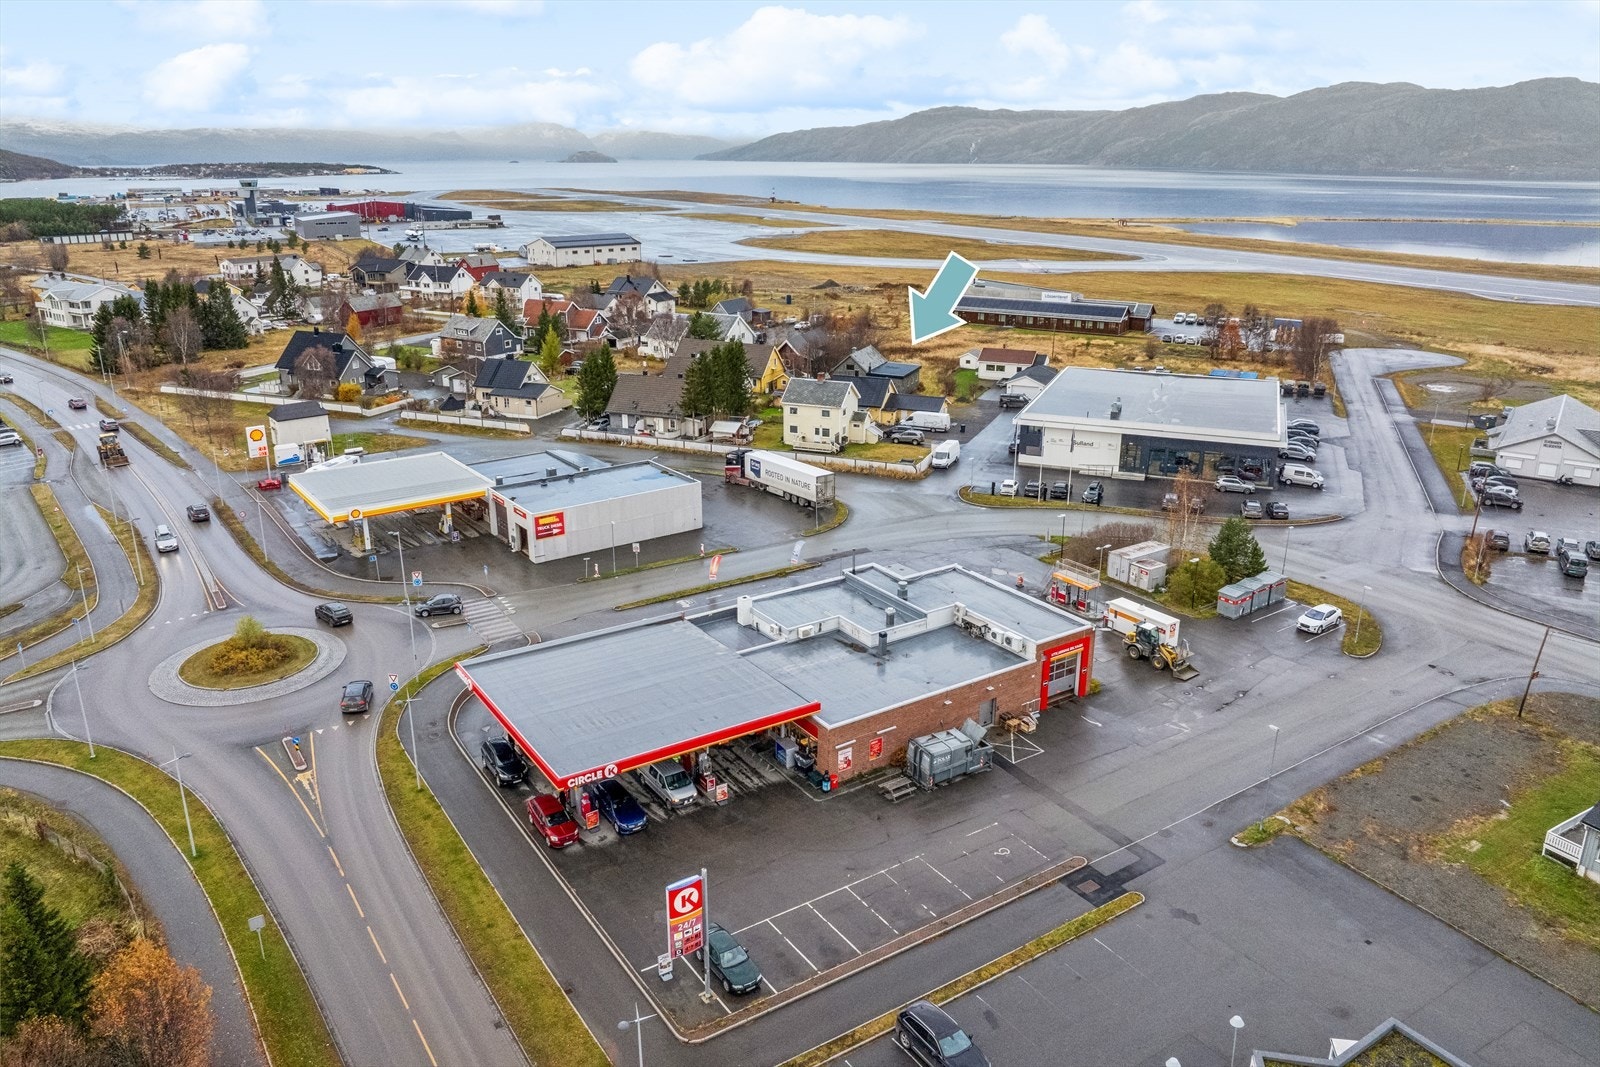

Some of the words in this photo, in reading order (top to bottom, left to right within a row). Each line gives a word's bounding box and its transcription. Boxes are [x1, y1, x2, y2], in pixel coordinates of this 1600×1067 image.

[764, 468, 783, 481] ROOTED
[784, 475, 790, 484] IN
[791, 478, 812, 490] NATURE
[568, 770, 603, 788] CIRCLE
[606, 765, 617, 777] K
[678, 890, 698, 911] K
[678, 918, 696, 931] 24/7
